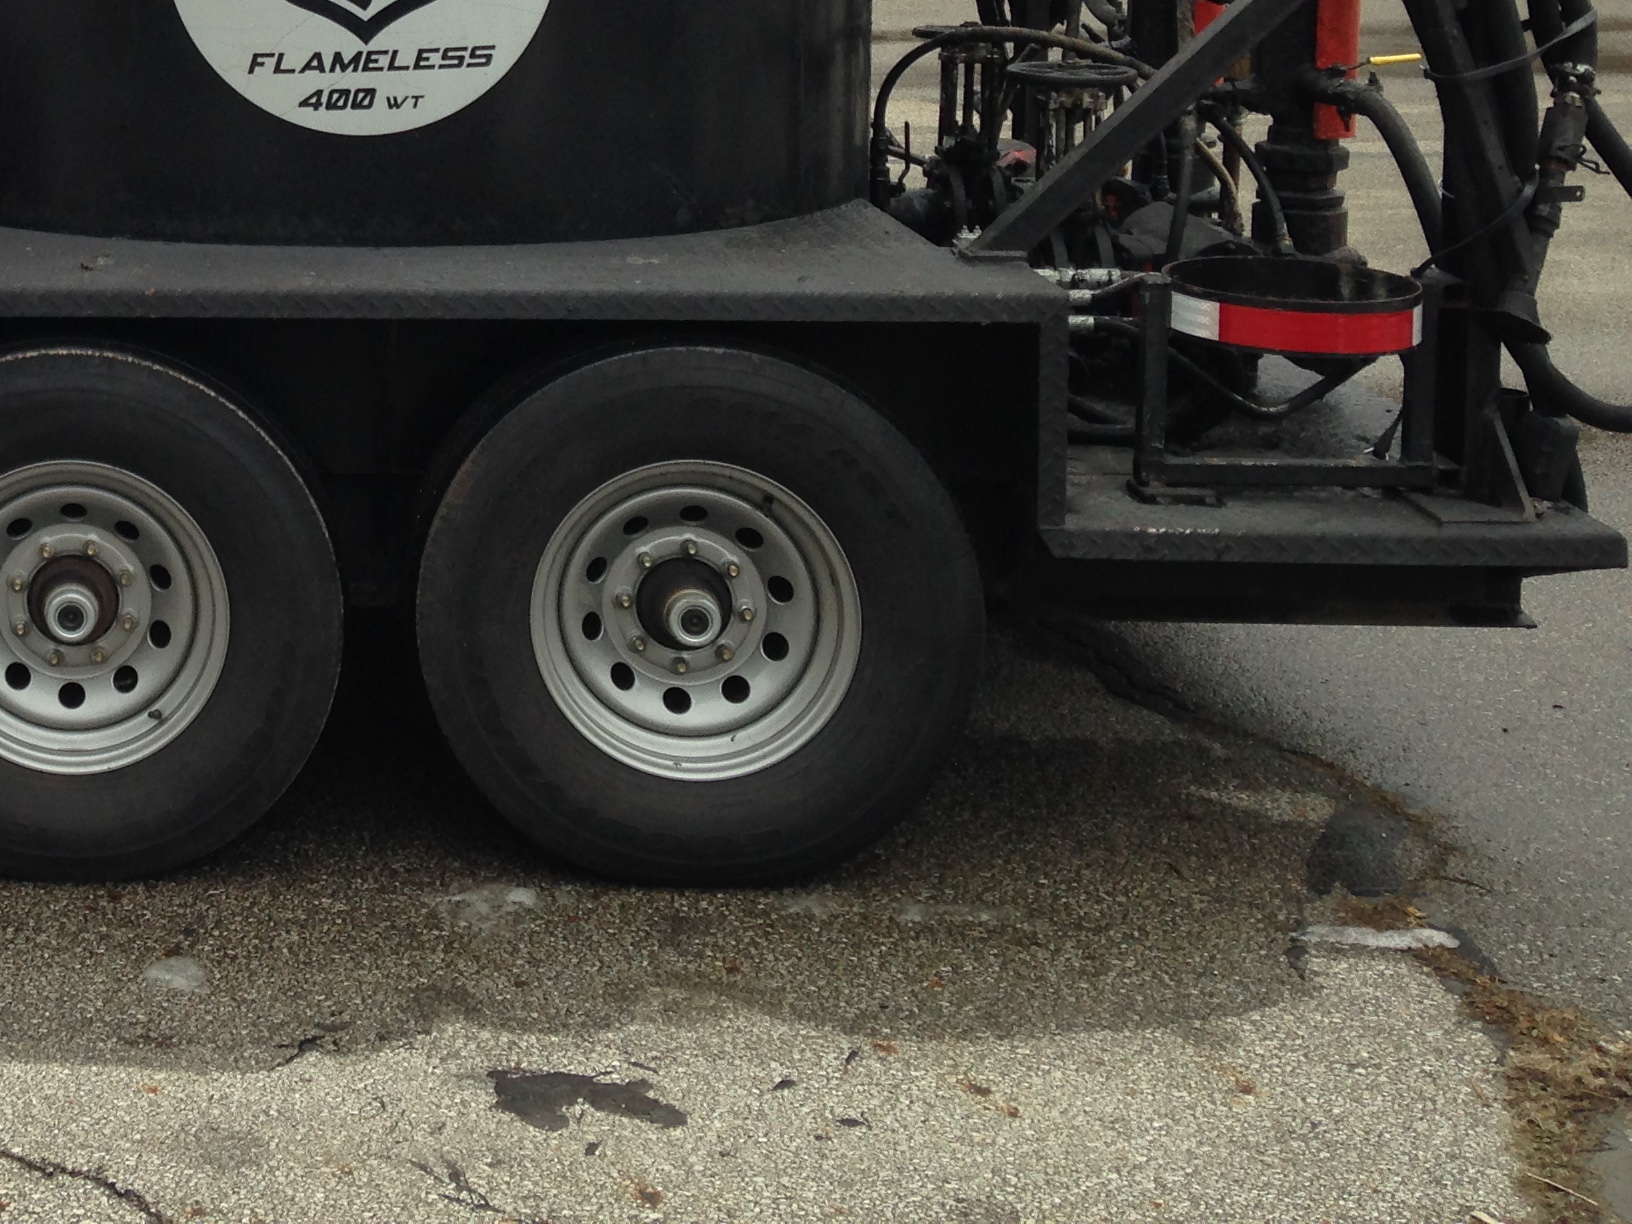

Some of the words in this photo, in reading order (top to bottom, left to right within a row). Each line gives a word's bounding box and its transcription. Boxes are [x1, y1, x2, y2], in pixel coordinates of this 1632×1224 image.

[247, 44, 496, 75] FLAMELESS
[298, 88, 377, 111] 400
[386, 95, 425, 110] WT
